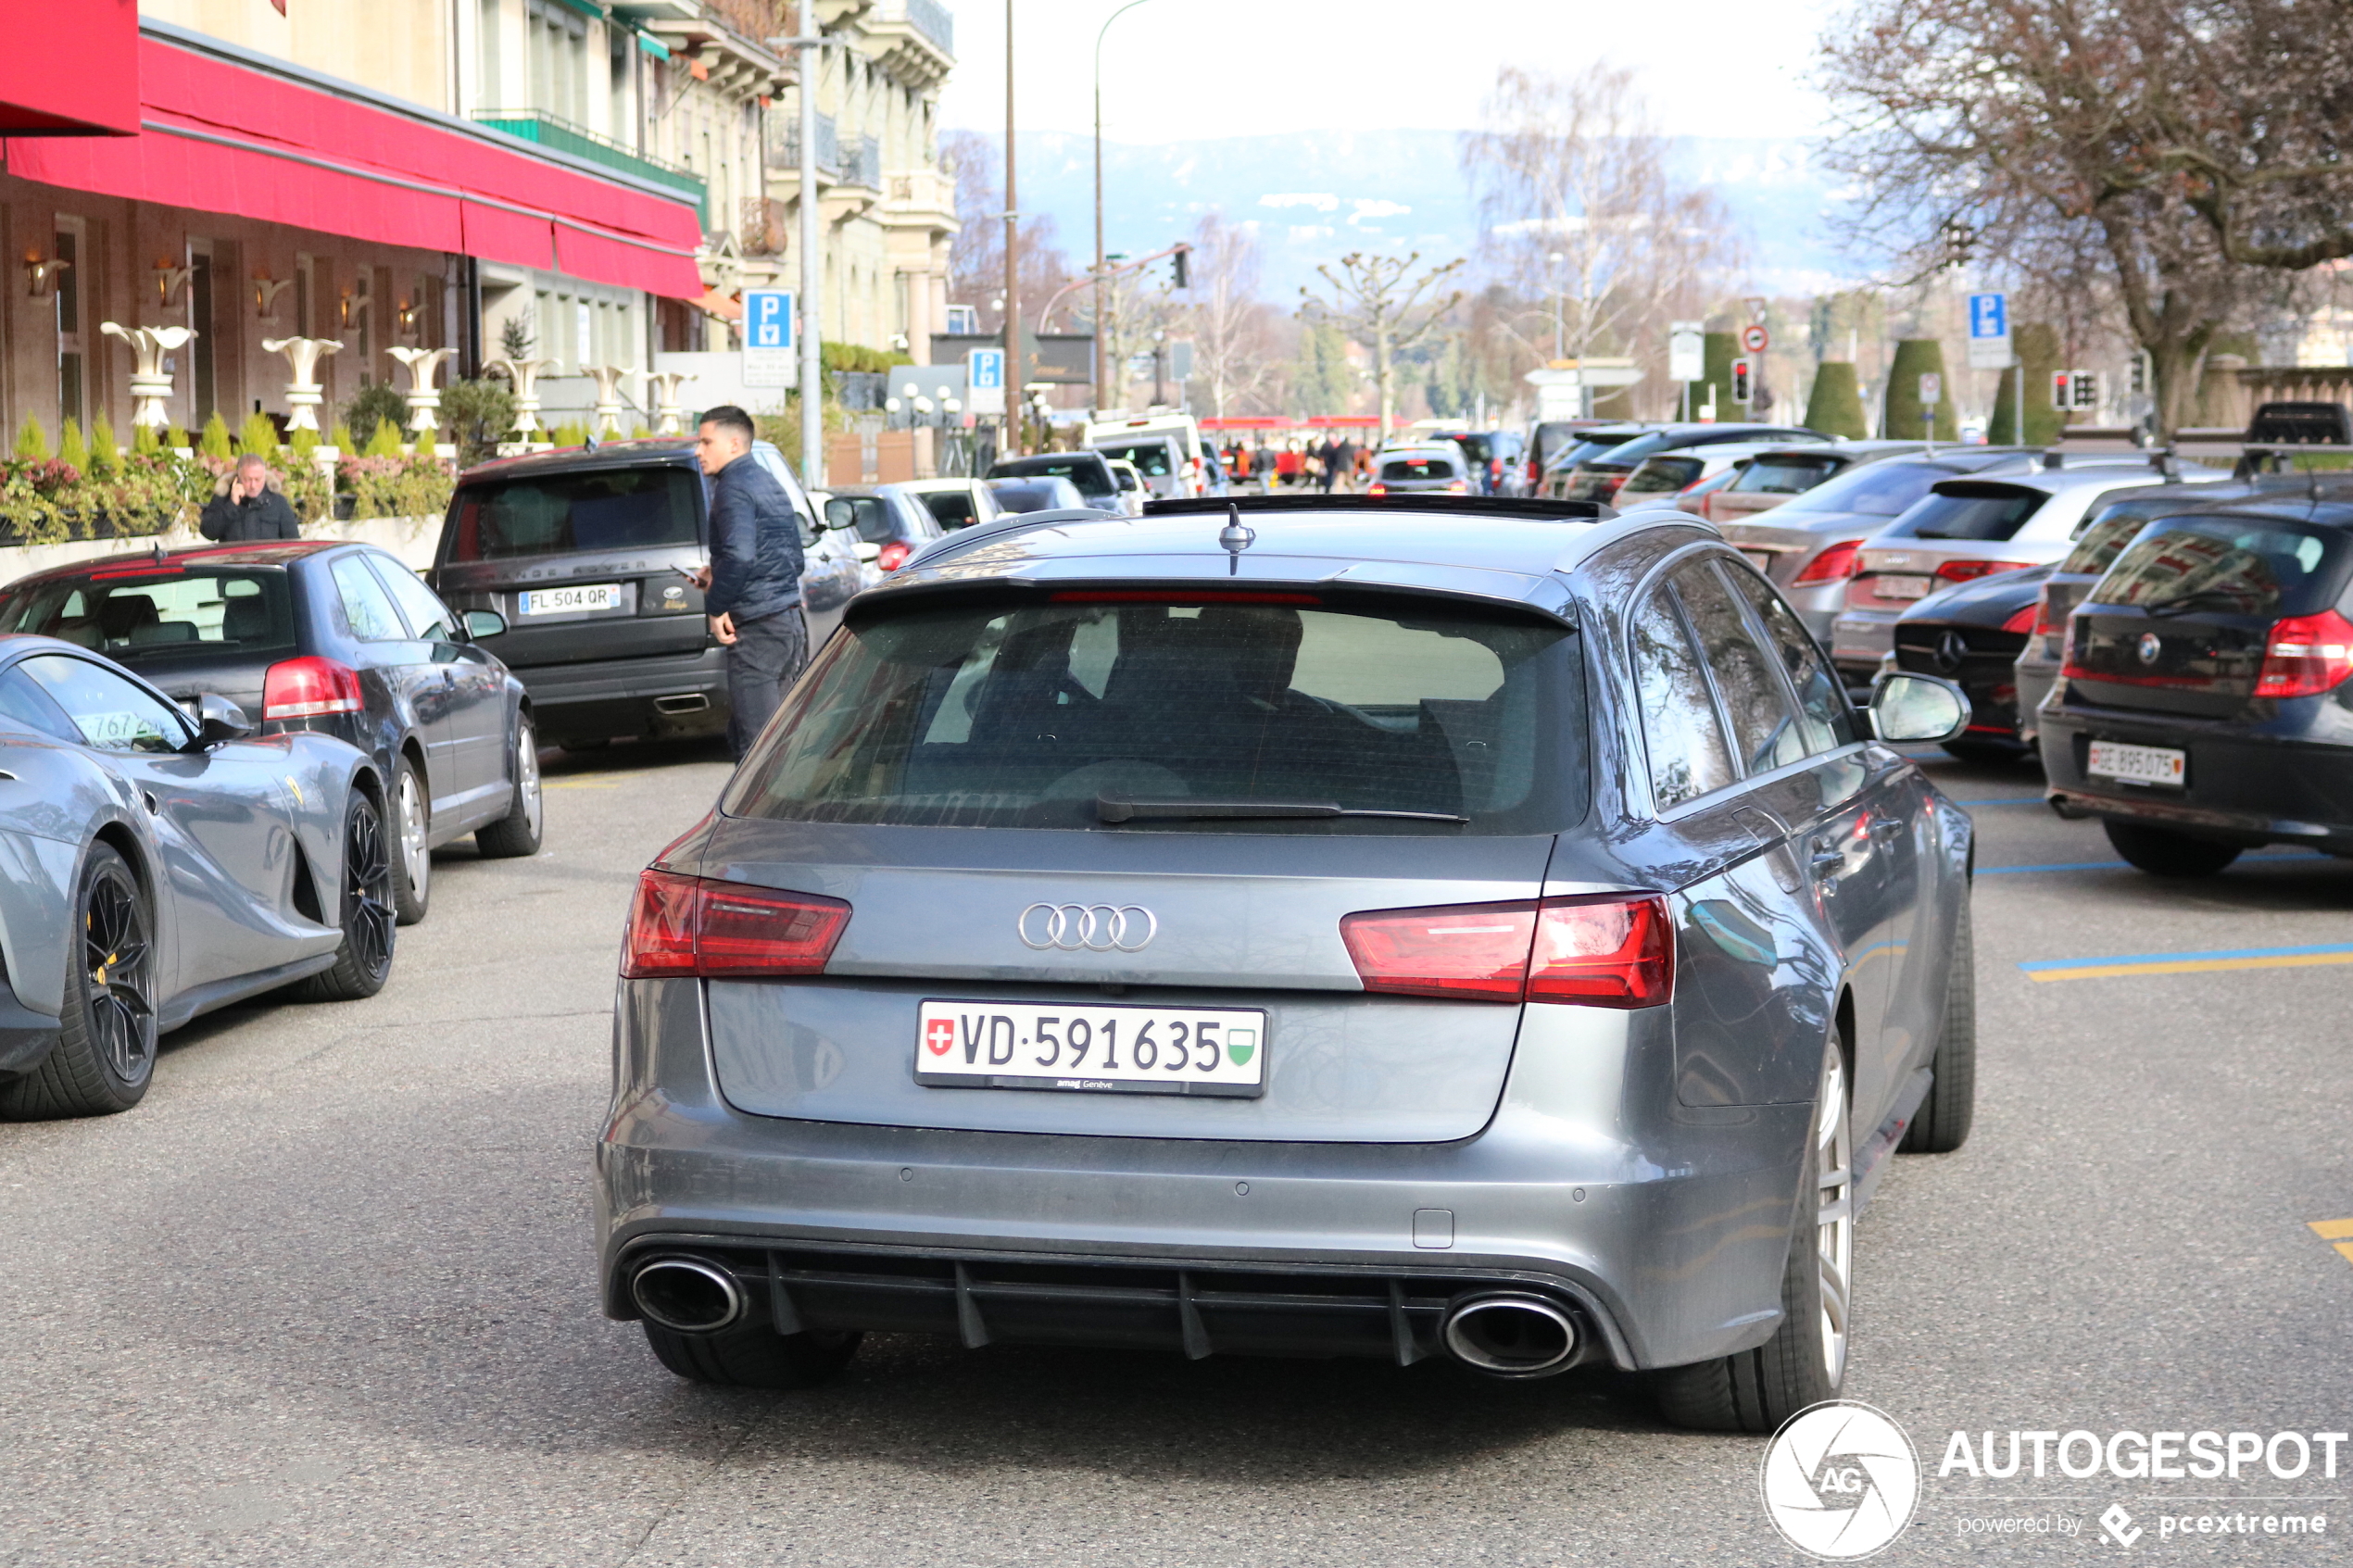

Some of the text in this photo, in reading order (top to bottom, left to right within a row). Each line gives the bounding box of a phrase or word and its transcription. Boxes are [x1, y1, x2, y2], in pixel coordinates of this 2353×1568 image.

[761, 295, 779, 323] P
[1980, 296, 1995, 317] P
[980, 353, 995, 370] P
[1057, 1080, 1114, 1089] amag Genève
